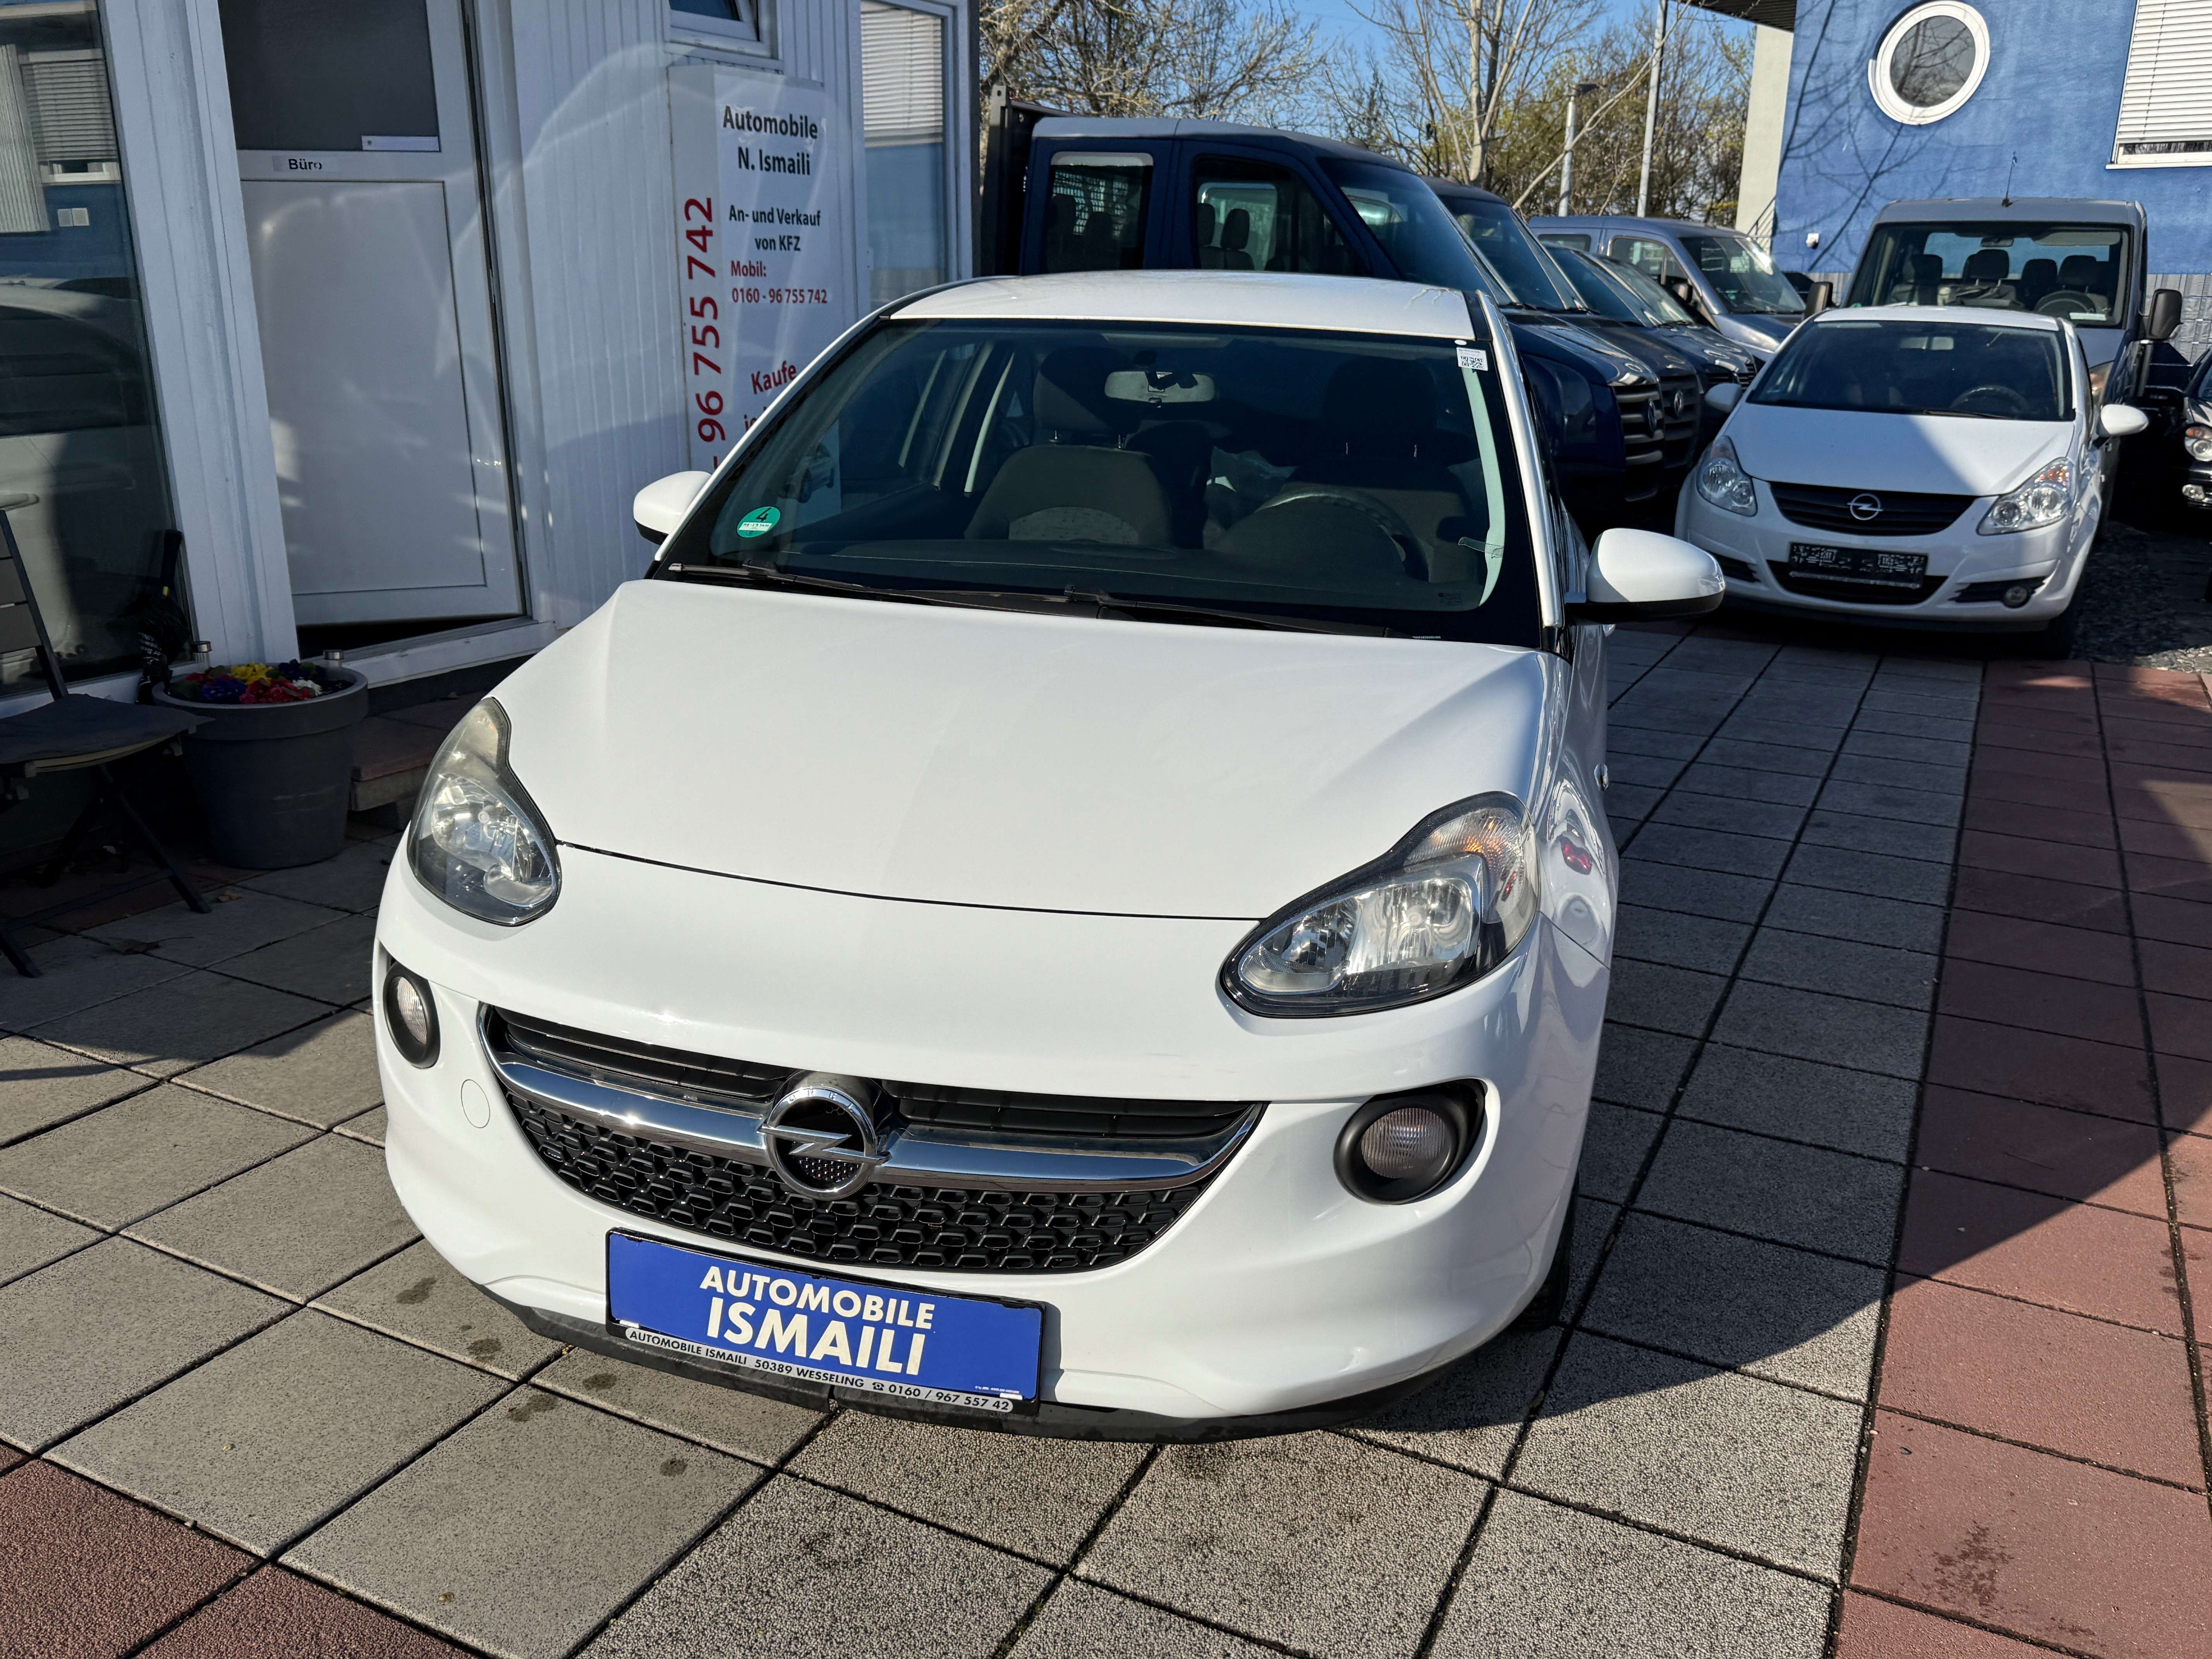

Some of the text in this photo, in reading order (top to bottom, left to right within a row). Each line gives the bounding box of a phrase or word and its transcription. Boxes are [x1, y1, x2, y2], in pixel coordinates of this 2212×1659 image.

[723, 105, 818, 139] Automobile
[288, 158, 322, 170] Büro
[738, 146, 810, 175] N. Ismaili
[729, 205, 821, 226] An- und Verkauf
[755, 235, 800, 251] von KFZ
[731, 260, 766, 277] Mobil:
[732, 288, 760, 303] 0160
[751, 361, 797, 395] Kaufe
[756, 507, 772, 522] 4
[699, 1266, 935, 1329] AUTOMOBILE
[707, 1297, 926, 1376] ISMAILI
[630, 1331, 1009, 1411] AUTOMOBILE ISMAILI 50389 WESSELING 0160 / 967 557 42
